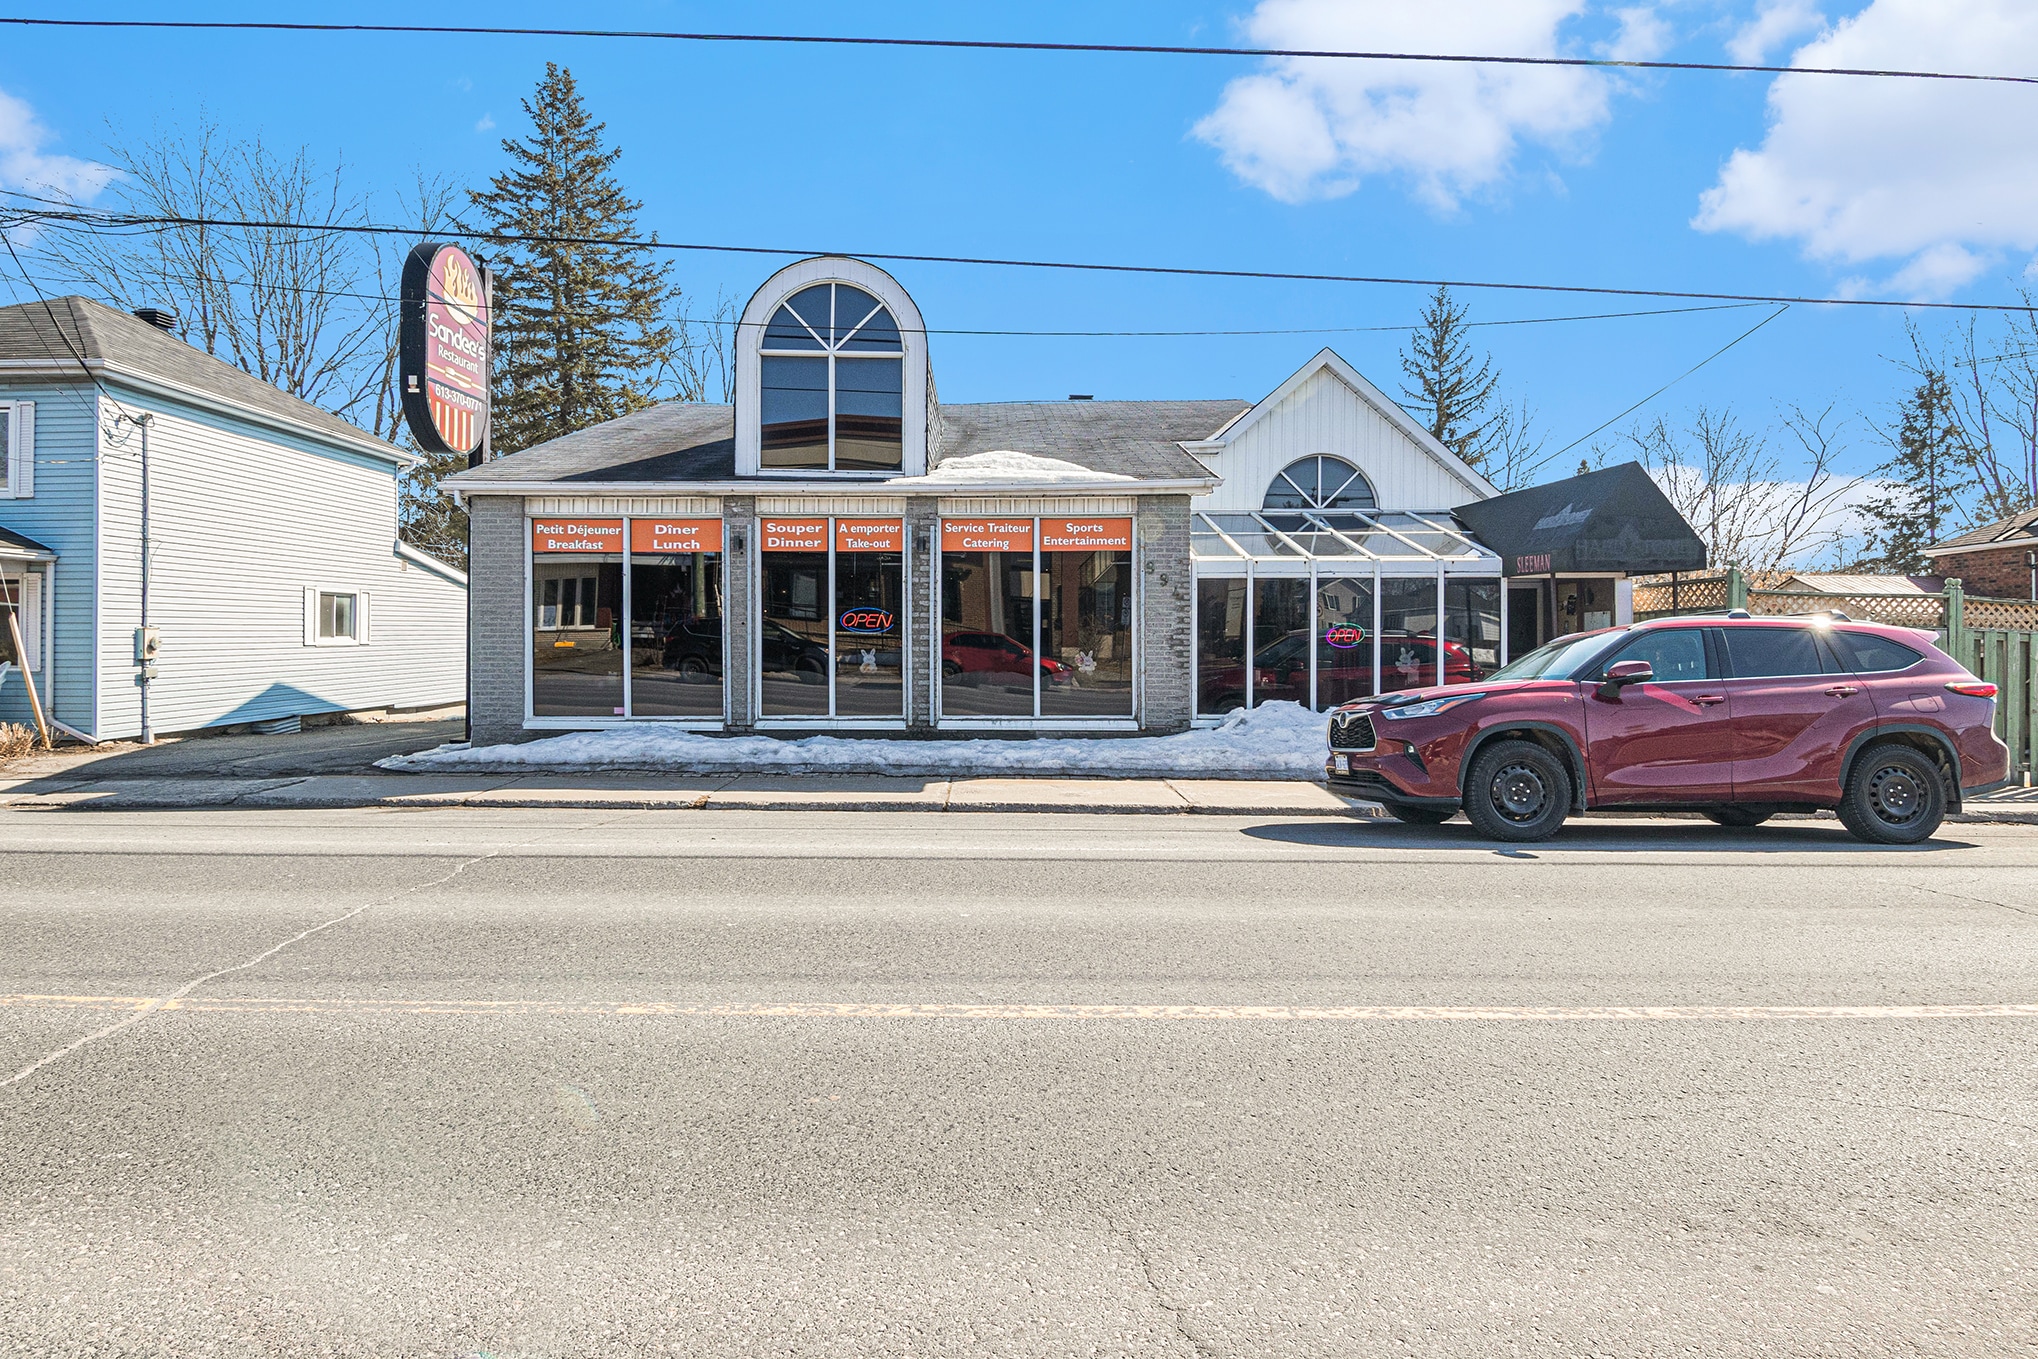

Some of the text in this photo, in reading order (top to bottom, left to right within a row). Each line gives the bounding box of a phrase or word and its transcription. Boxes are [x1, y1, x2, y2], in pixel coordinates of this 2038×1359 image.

[429, 313, 486, 361] Sandee's
[438, 344, 479, 374] Restaurant
[435, 384, 482, 412] 613-370-0771
[536, 524, 621, 537] Petit Déjeuner
[655, 525, 699, 535] Dîner
[766, 523, 823, 534] Souper
[839, 523, 900, 535] A emporter
[945, 523, 1031, 533] Service Traiteur
[1066, 523, 1103, 534] Sports
[547, 540, 604, 550] Breakfast
[653, 540, 700, 550] Lunch
[767, 537, 822, 548] Dinner
[846, 538, 891, 548] Take-out
[963, 538, 1009, 550] Catering
[1044, 536, 1126, 546] Entertainment
[1517, 554, 1550, 573] SLEEMAN
[843, 612, 893, 628] OPEN
[1329, 629, 1361, 642] OPEN
